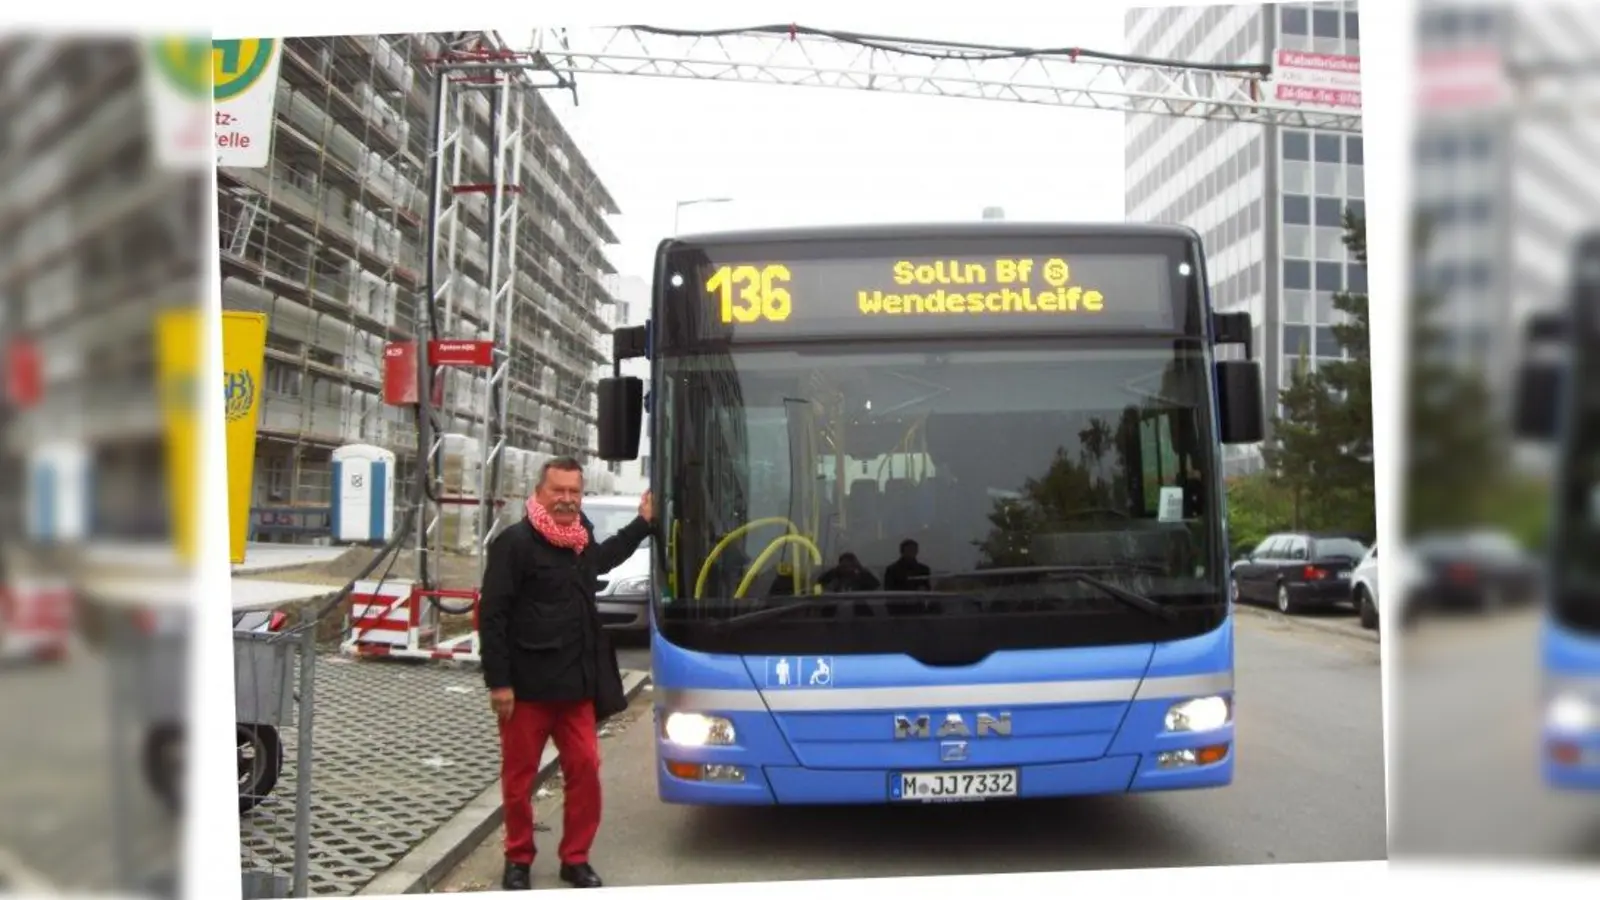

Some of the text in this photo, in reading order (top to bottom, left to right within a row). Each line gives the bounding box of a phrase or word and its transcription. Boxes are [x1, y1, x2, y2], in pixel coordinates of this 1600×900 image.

[215, 132, 250, 148] elle
[893, 260, 986, 285] Solln
[996, 258, 1033, 284] Bf
[706, 264, 791, 323] 136
[858, 286, 1104, 314] Wendeschleife
[894, 712, 1012, 739] MAN
[903, 777, 917, 796] M
